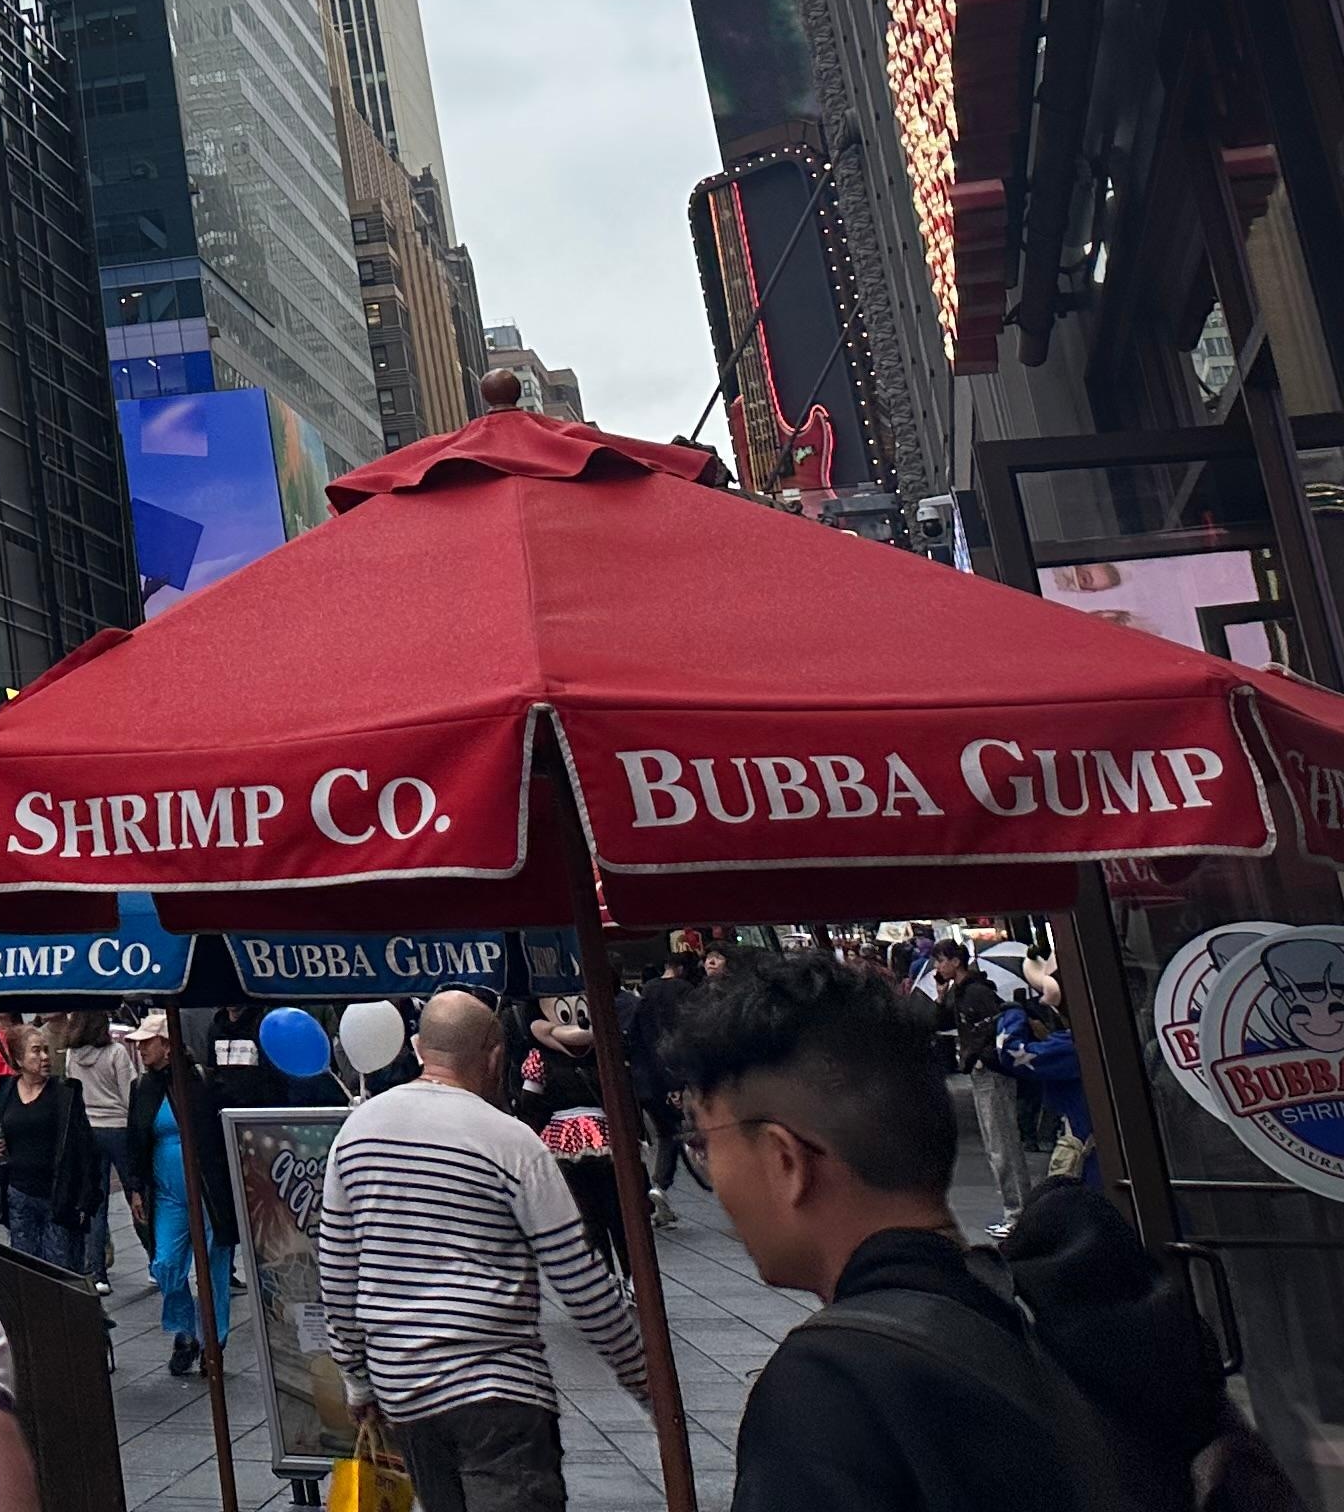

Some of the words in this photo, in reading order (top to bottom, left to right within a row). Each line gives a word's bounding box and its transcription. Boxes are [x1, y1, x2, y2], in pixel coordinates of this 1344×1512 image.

[615, 747, 946, 830] BUBBA
[960, 737, 1225, 818] GUMP
[7, 783, 286, 859] SHRIMP
[242, 938, 377, 979] BUBBA
[384, 935, 503, 978] GUMP
[1280, 1103, 1344, 1125] SHRI
